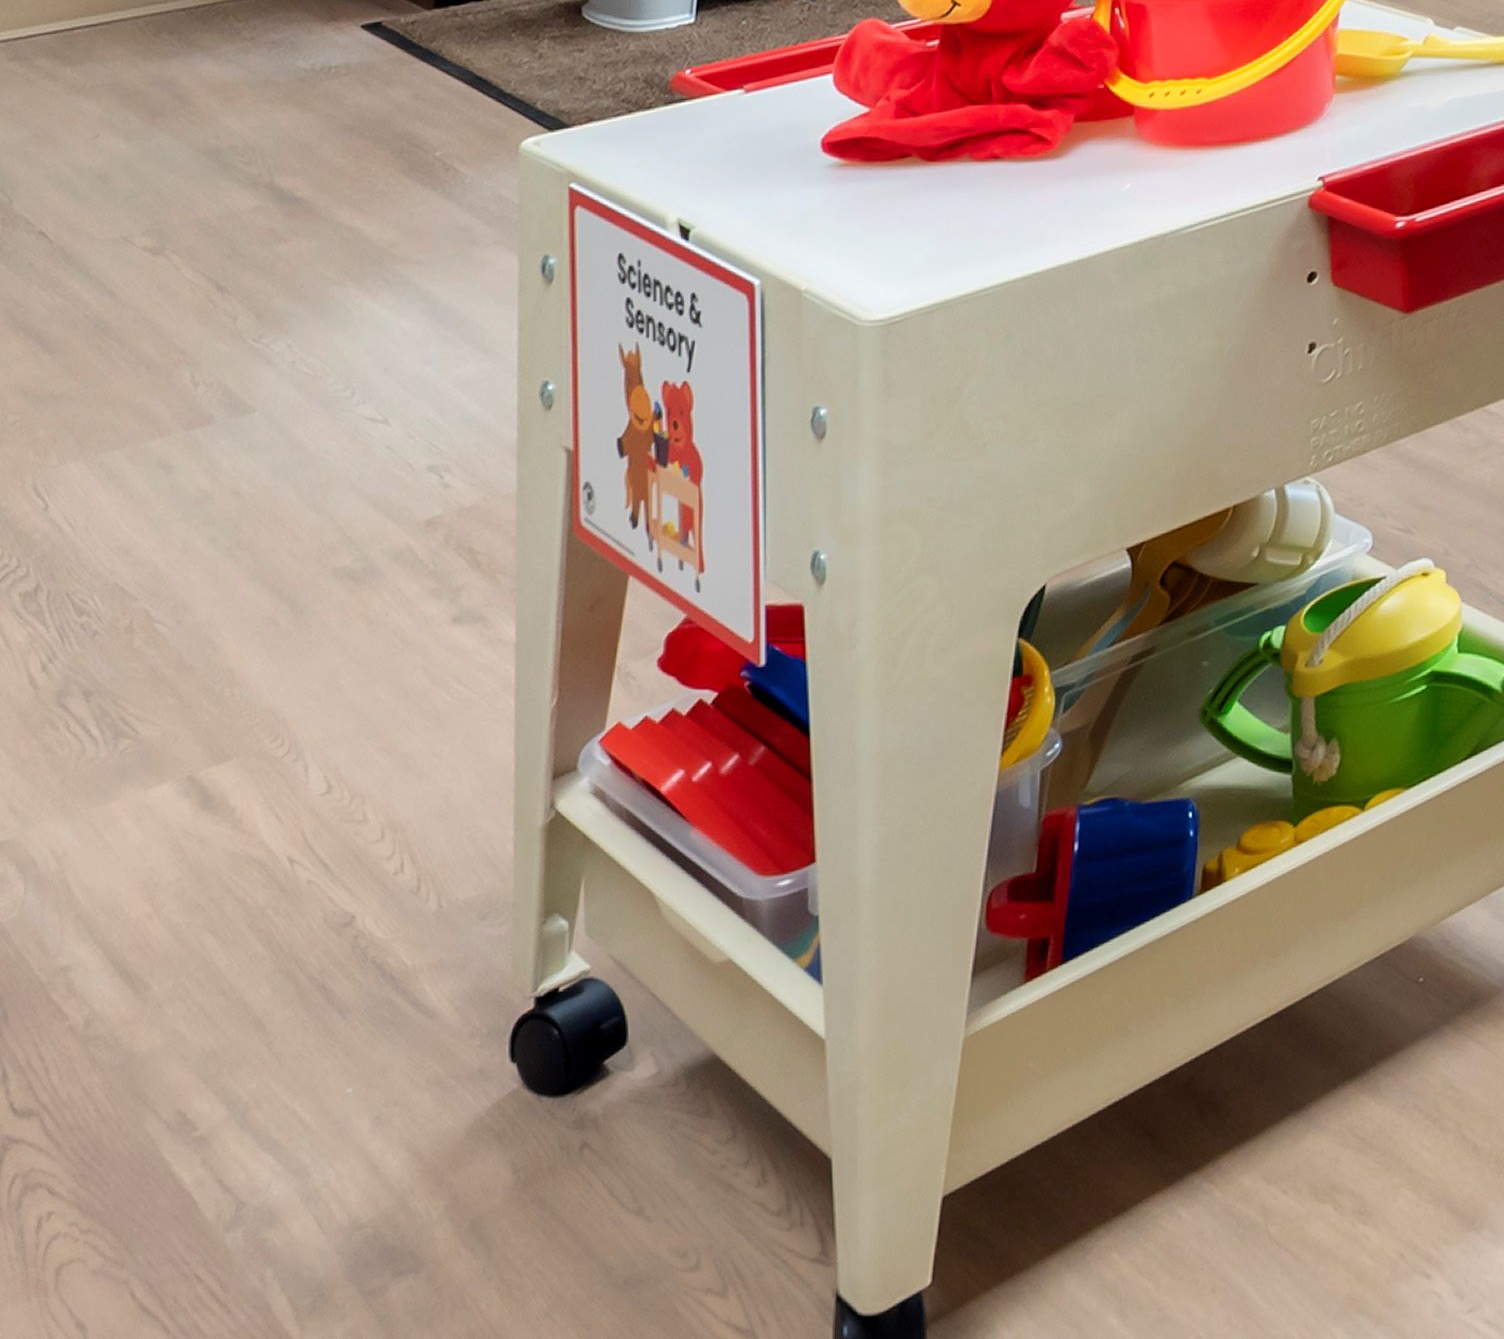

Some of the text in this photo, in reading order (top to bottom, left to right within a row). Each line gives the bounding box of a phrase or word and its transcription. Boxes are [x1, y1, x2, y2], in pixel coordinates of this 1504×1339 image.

[617, 252, 702, 328] Science &
[624, 297, 696, 373] Sensory
